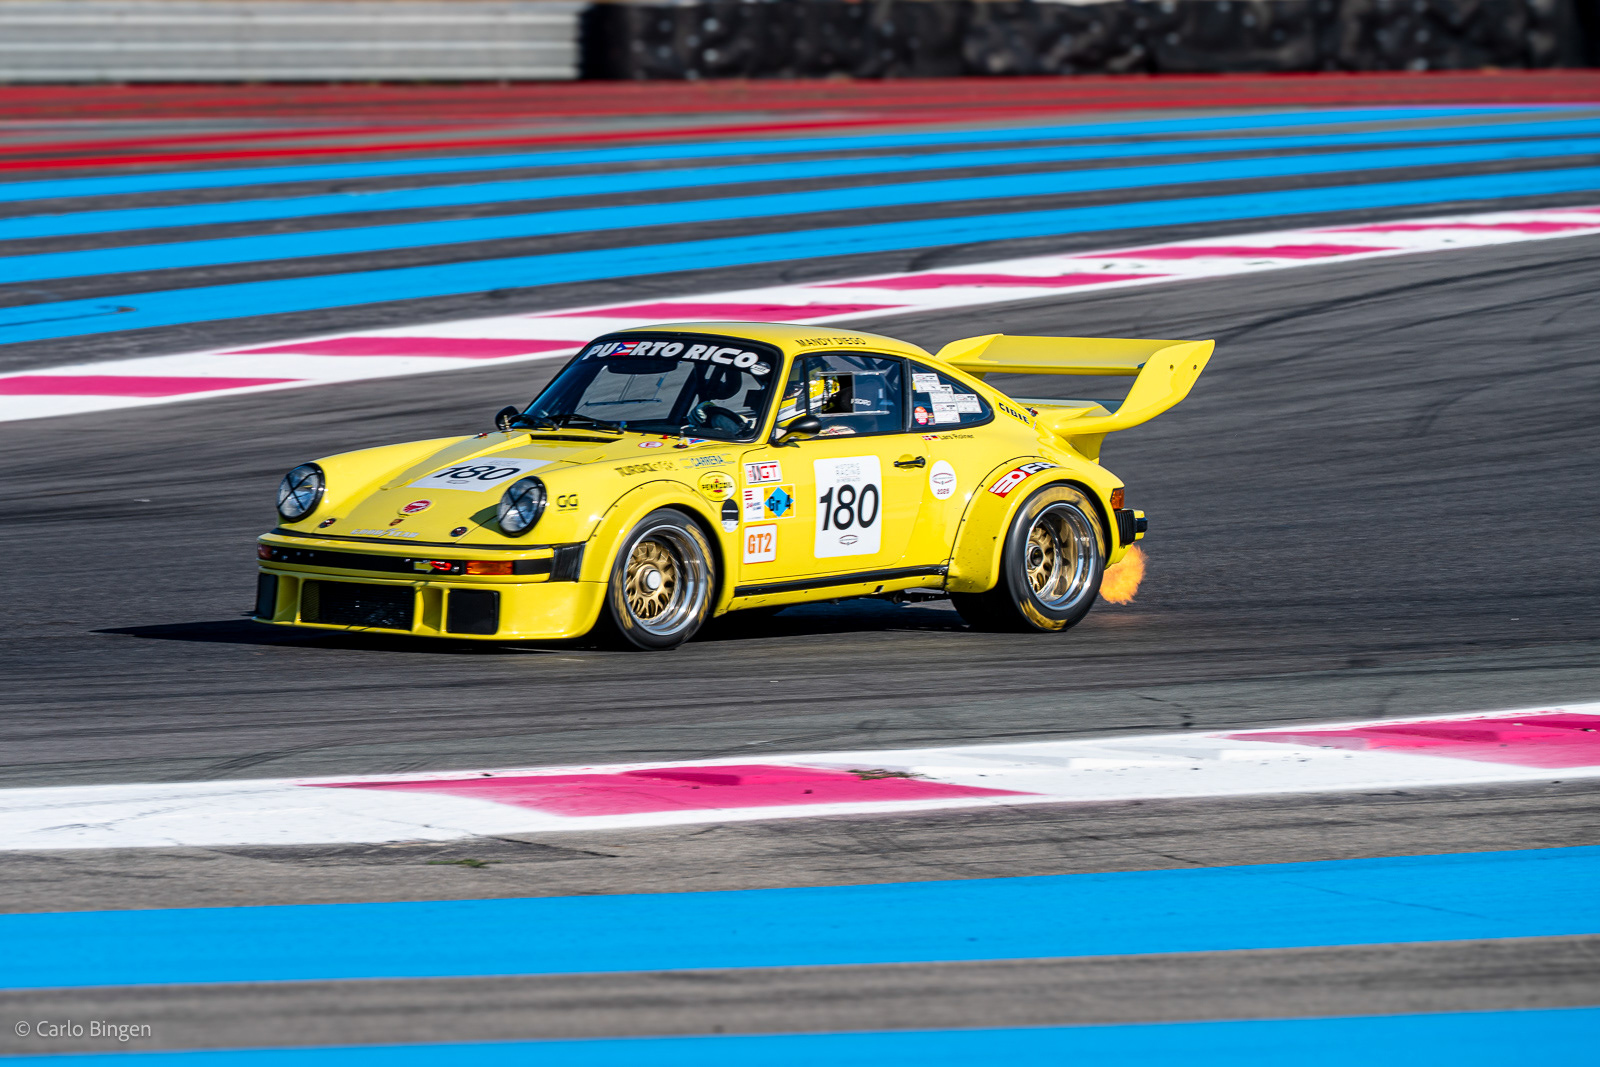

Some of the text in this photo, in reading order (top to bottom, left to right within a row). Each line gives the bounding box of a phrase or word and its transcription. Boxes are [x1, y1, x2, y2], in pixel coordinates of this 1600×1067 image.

[795, 337, 866, 347] MANDY DIEGO
[582, 341, 759, 368] PUERTO RICO
[432, 465, 521, 481] 180
[556, 494, 578, 508] GG
[819, 483, 879, 531] 180
[747, 532, 772, 555] GT2
